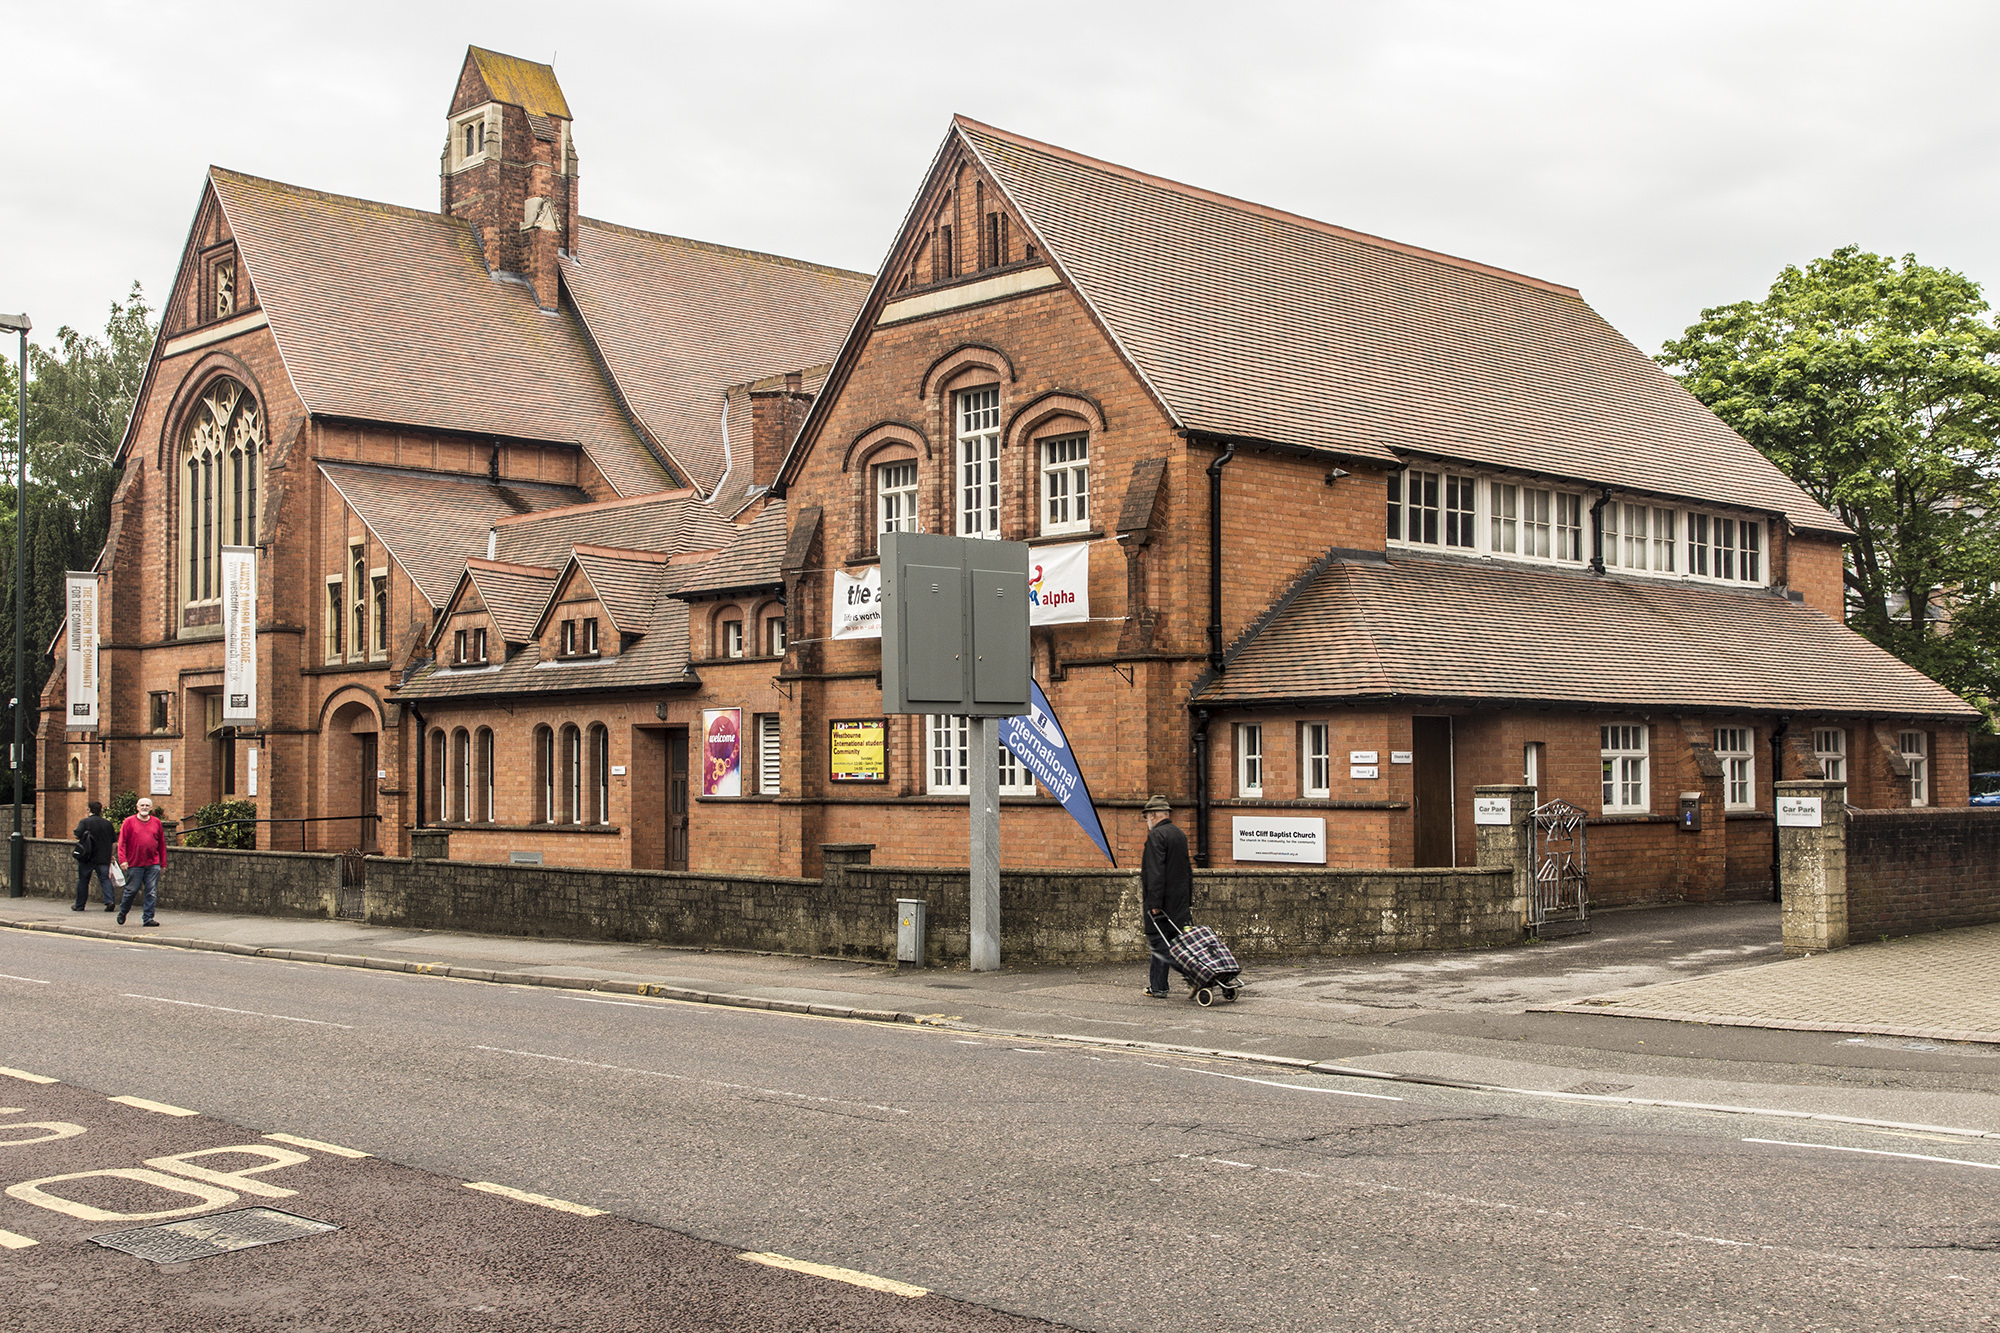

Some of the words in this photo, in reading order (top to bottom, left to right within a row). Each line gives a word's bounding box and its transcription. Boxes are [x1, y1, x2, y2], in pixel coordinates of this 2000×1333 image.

[240, 562, 250, 591] ALWAYS
[71, 585, 81, 598] FOR
[83, 586, 92, 598] THE
[847, 584, 871, 606] the
[1042, 590, 1075, 608] alpha
[71, 600, 81, 612] THE
[83, 599, 92, 626] CHURCH
[240, 599, 250, 624] WARM
[853, 612, 859, 621] is
[860, 612, 880, 620] worth
[71, 613, 81, 652] COMMUNITY
[83, 635, 92, 647] THE
[83, 649, 92, 689] COMMUNITY
[708, 732, 736, 743] welcome
[1008, 716, 1078, 790] International
[1008, 731, 1071, 804] Community
[1782, 805, 1796, 813] Car
[1269, 830, 1292, 839] Baptist
[1293, 831, 1316, 839] Church
